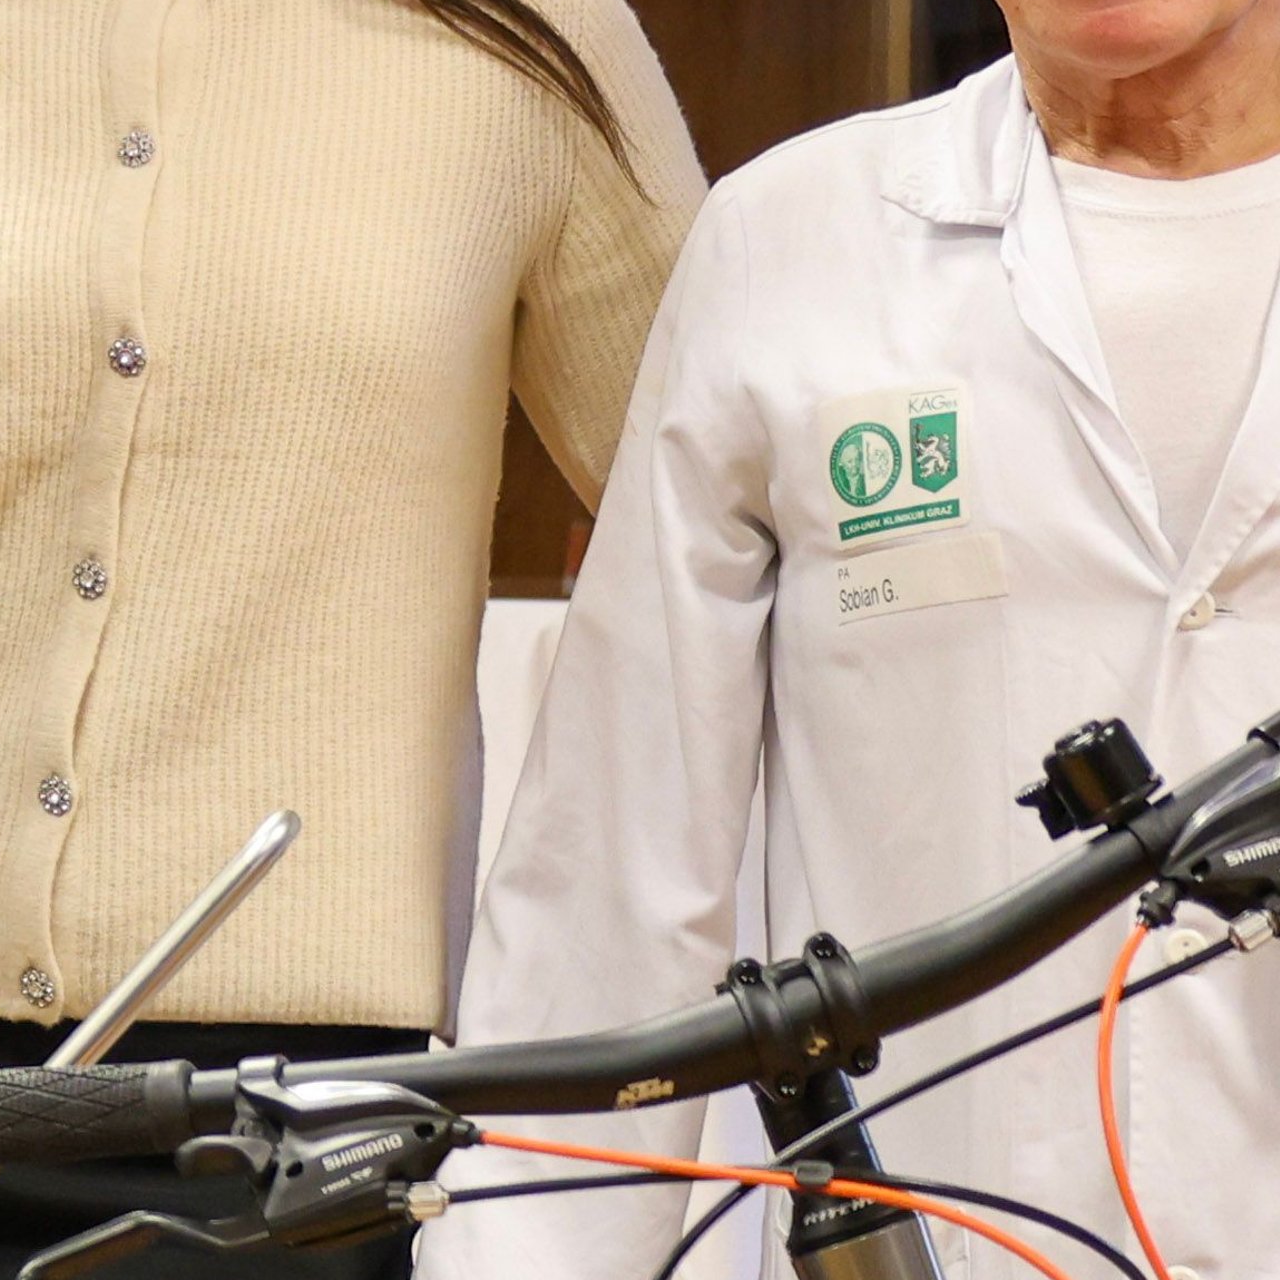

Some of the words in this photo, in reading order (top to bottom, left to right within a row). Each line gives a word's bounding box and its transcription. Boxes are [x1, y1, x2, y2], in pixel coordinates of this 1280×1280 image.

[927, 505, 954, 519] GRAZ
[882, 579, 900, 603] G.
[322, 1133, 404, 1173] SHIMANO
